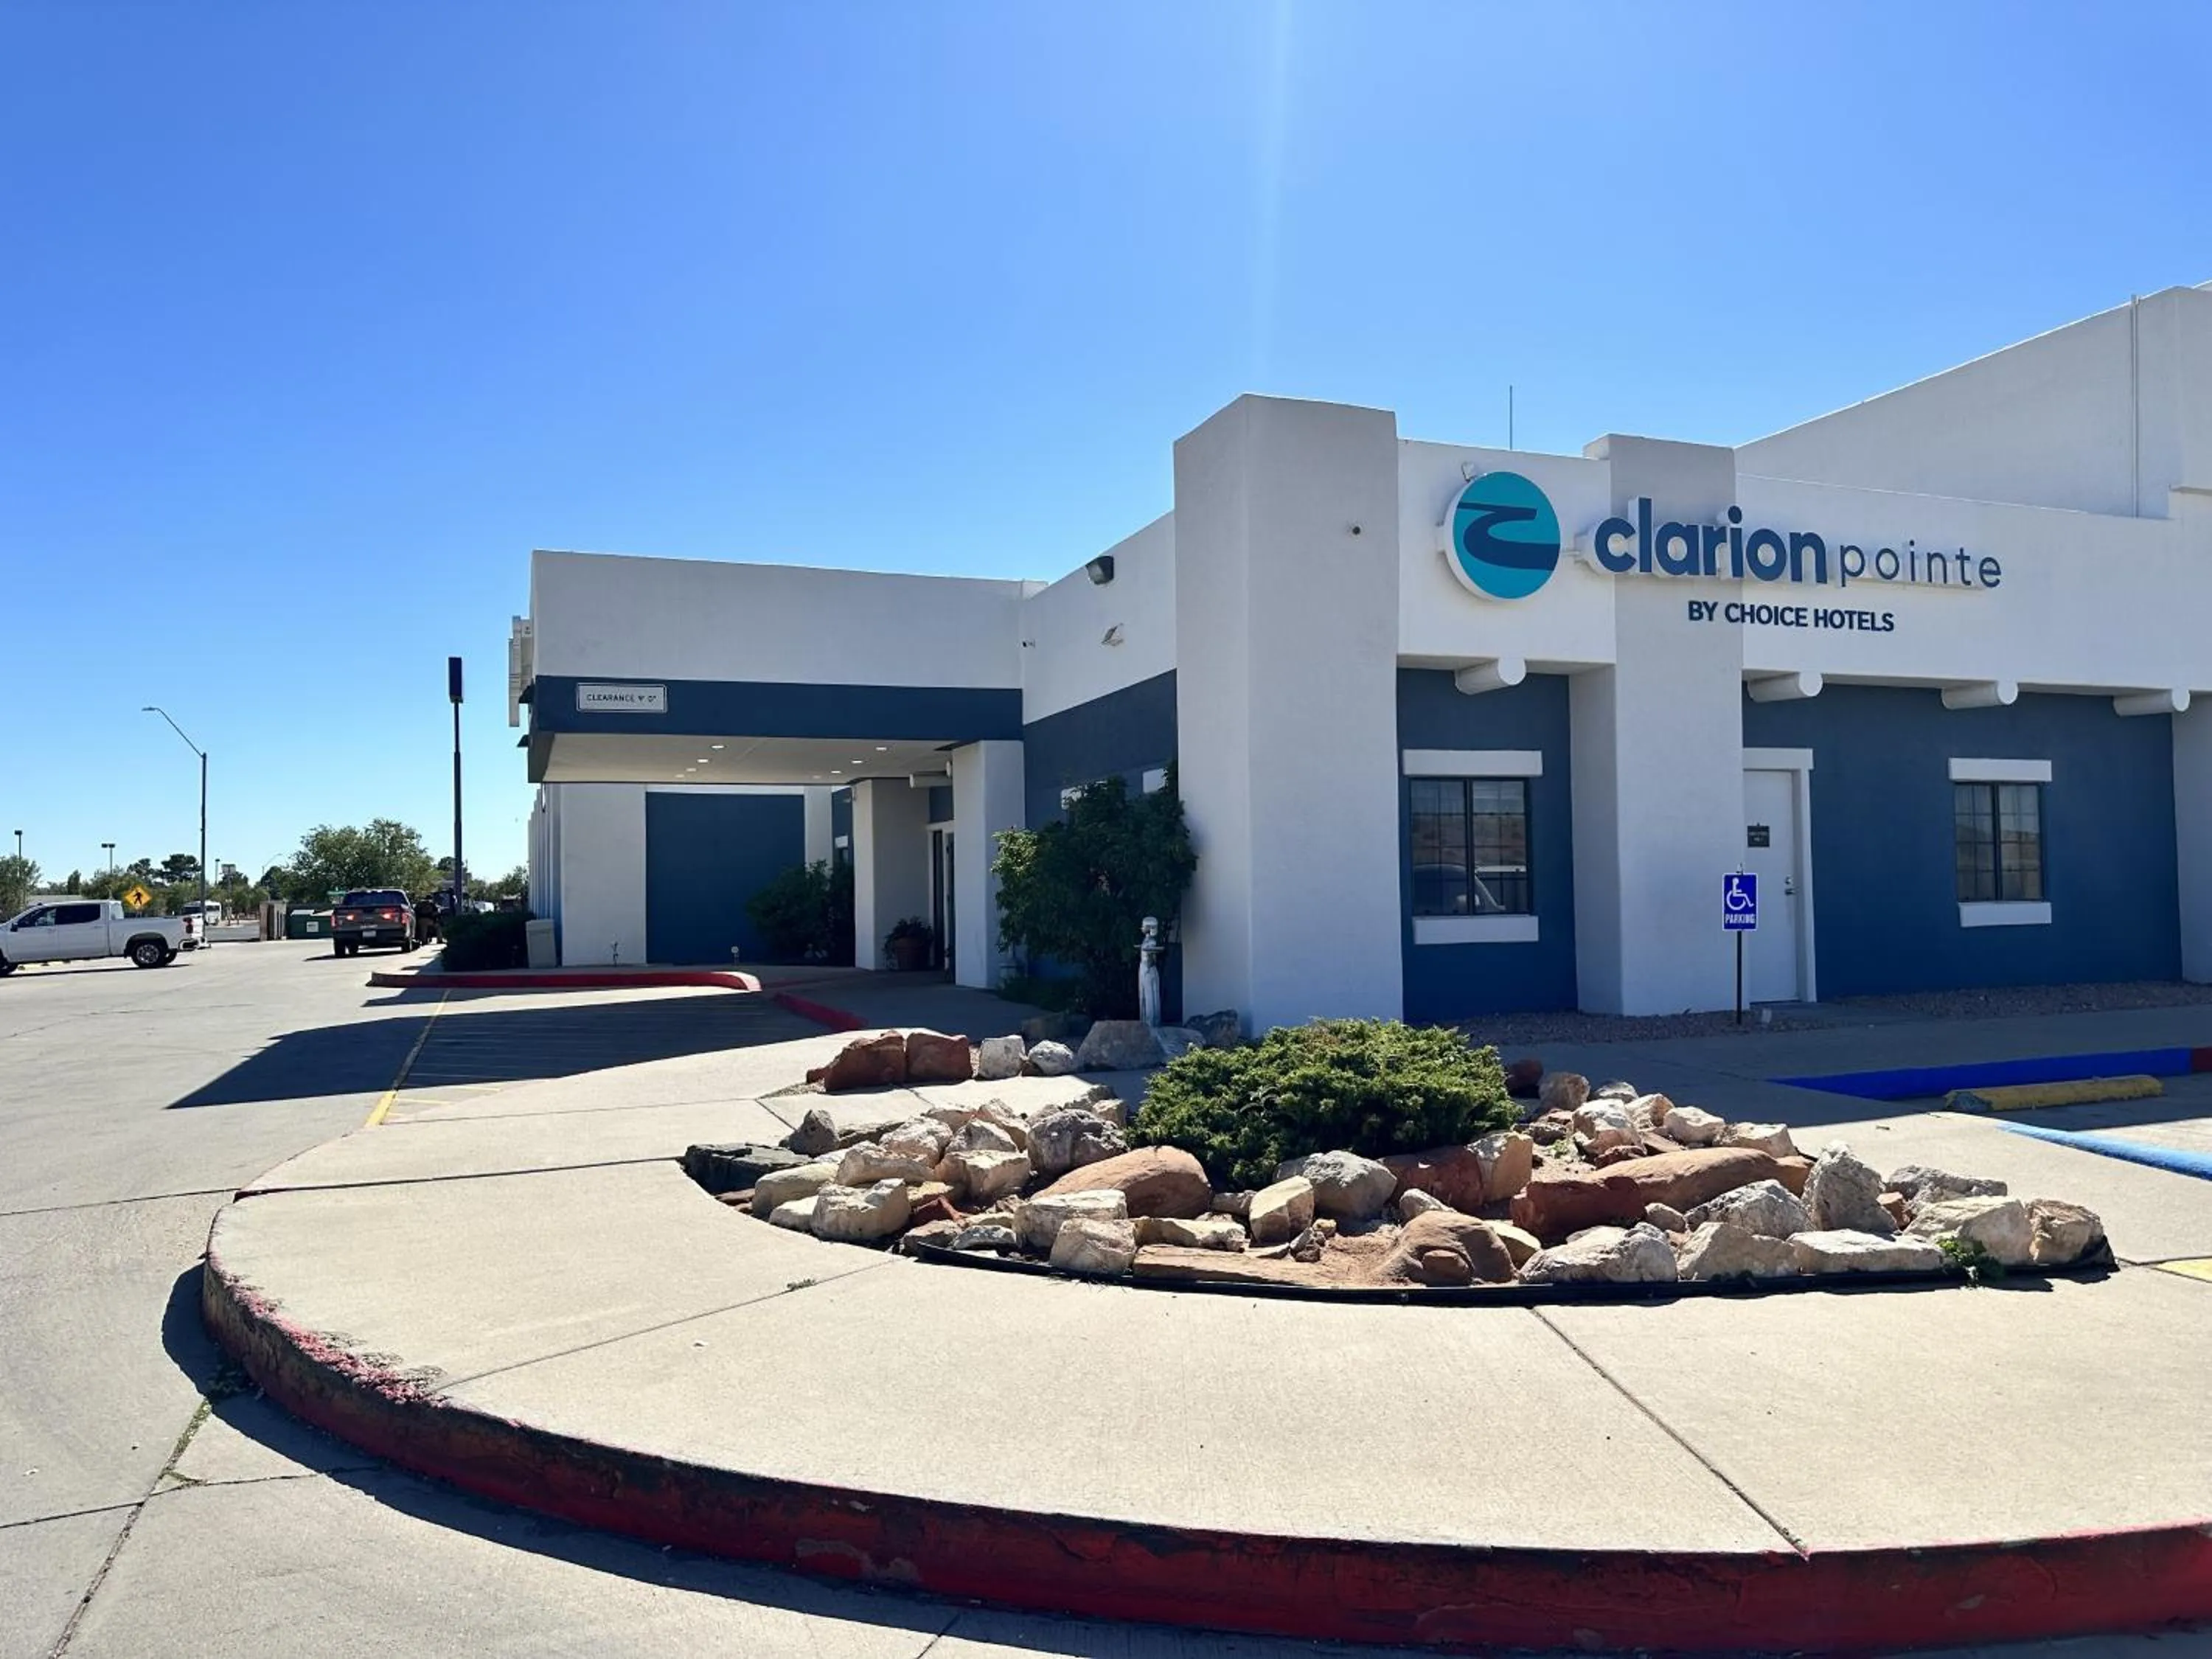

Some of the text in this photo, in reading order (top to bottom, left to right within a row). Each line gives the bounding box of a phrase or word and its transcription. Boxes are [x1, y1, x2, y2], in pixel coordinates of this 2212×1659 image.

[1595, 497, 2002, 588] clarion pointe
[1688, 600, 1895, 632] BY CHOICE HOTELS
[586, 693, 635, 703] CLEARANCE
[1725, 913, 1756, 925] PARKING
